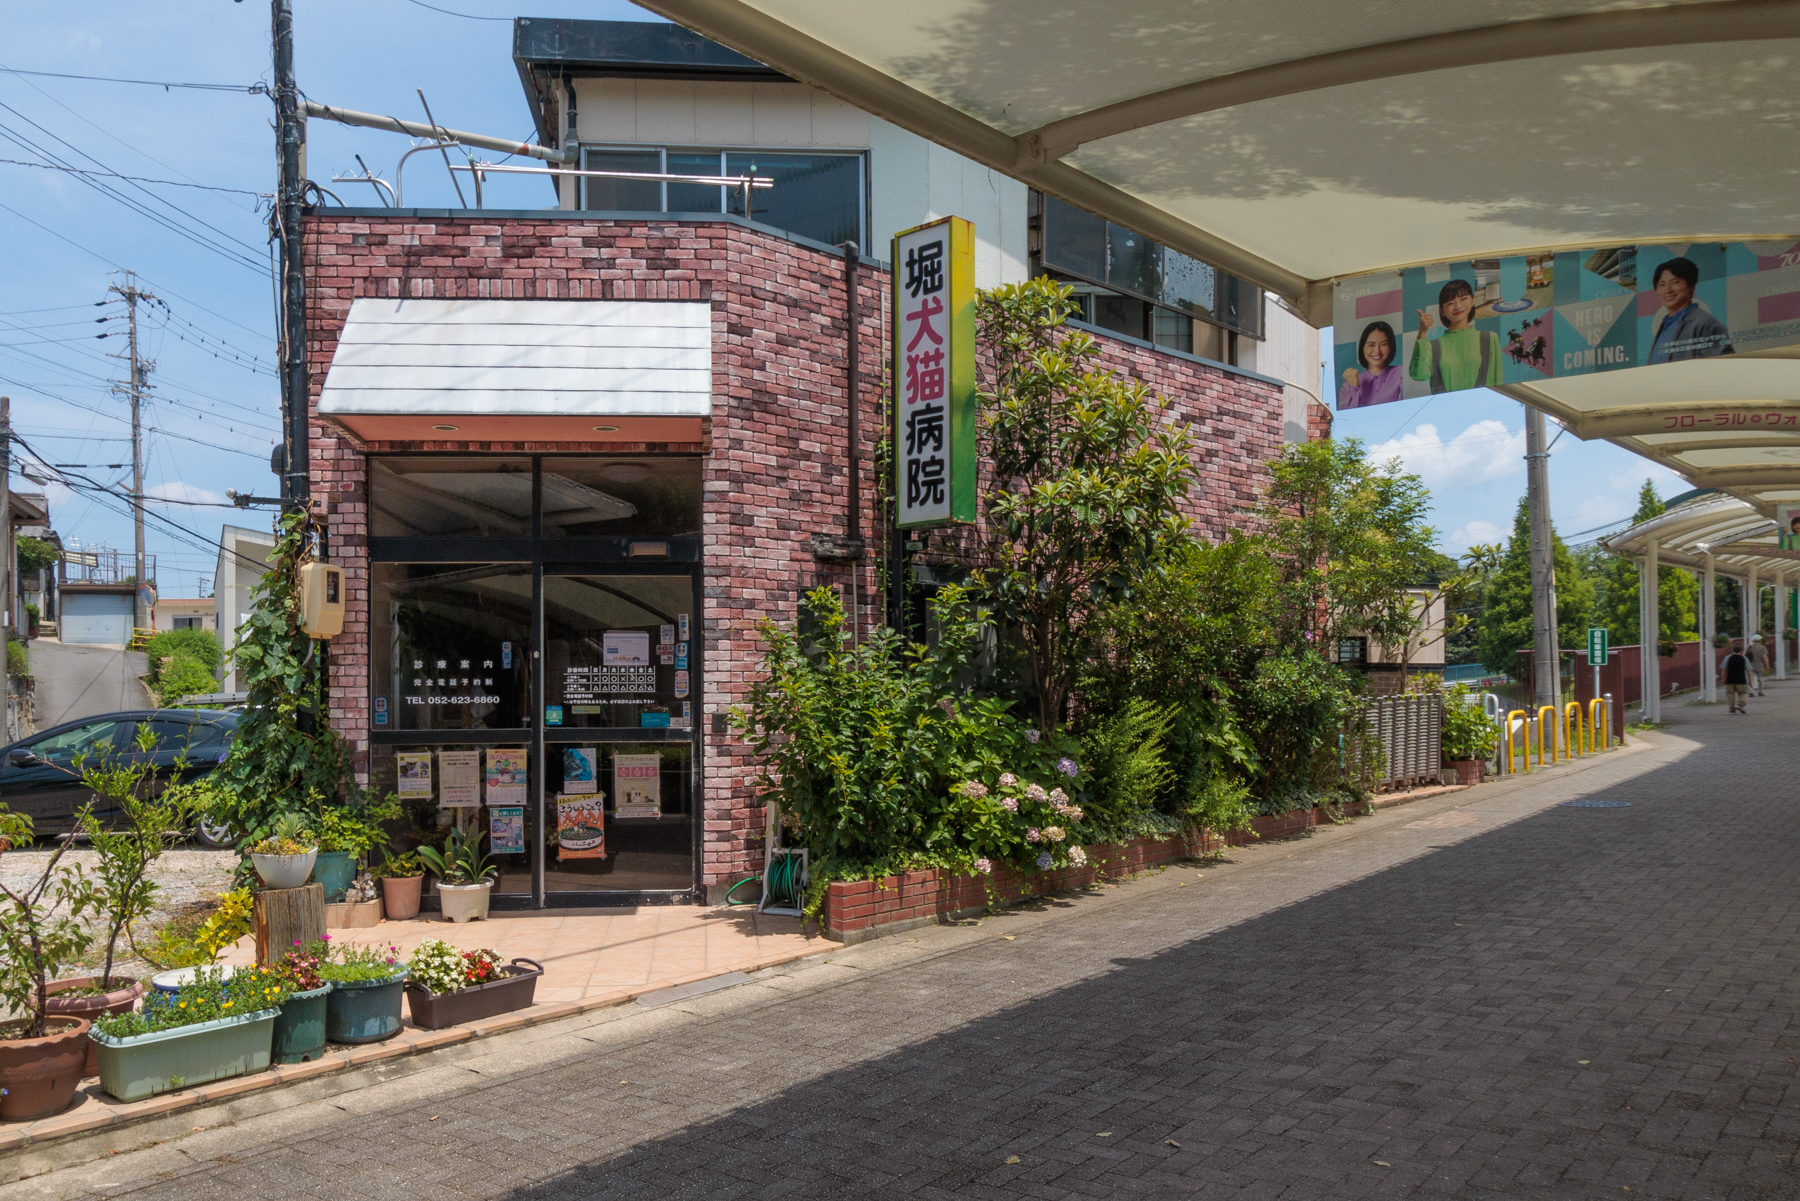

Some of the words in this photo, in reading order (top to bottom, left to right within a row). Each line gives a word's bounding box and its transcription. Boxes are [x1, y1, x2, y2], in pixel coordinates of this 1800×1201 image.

[1355, 287, 1371, 297] JRA
[1575, 304, 1614, 328] HERO
[1586, 327, 1602, 347] IS
[1563, 344, 1631, 371] COMING.
[905, 240, 945, 509] 堀犬猫病院
[1663, 412, 1748, 429] フローラル
[413, 678, 493, 687] 完全電話予約制
[405, 696, 426, 705] TEL
[427, 695, 501, 705] 052-623-6860
[558, 801, 602, 814] こういうこと?
